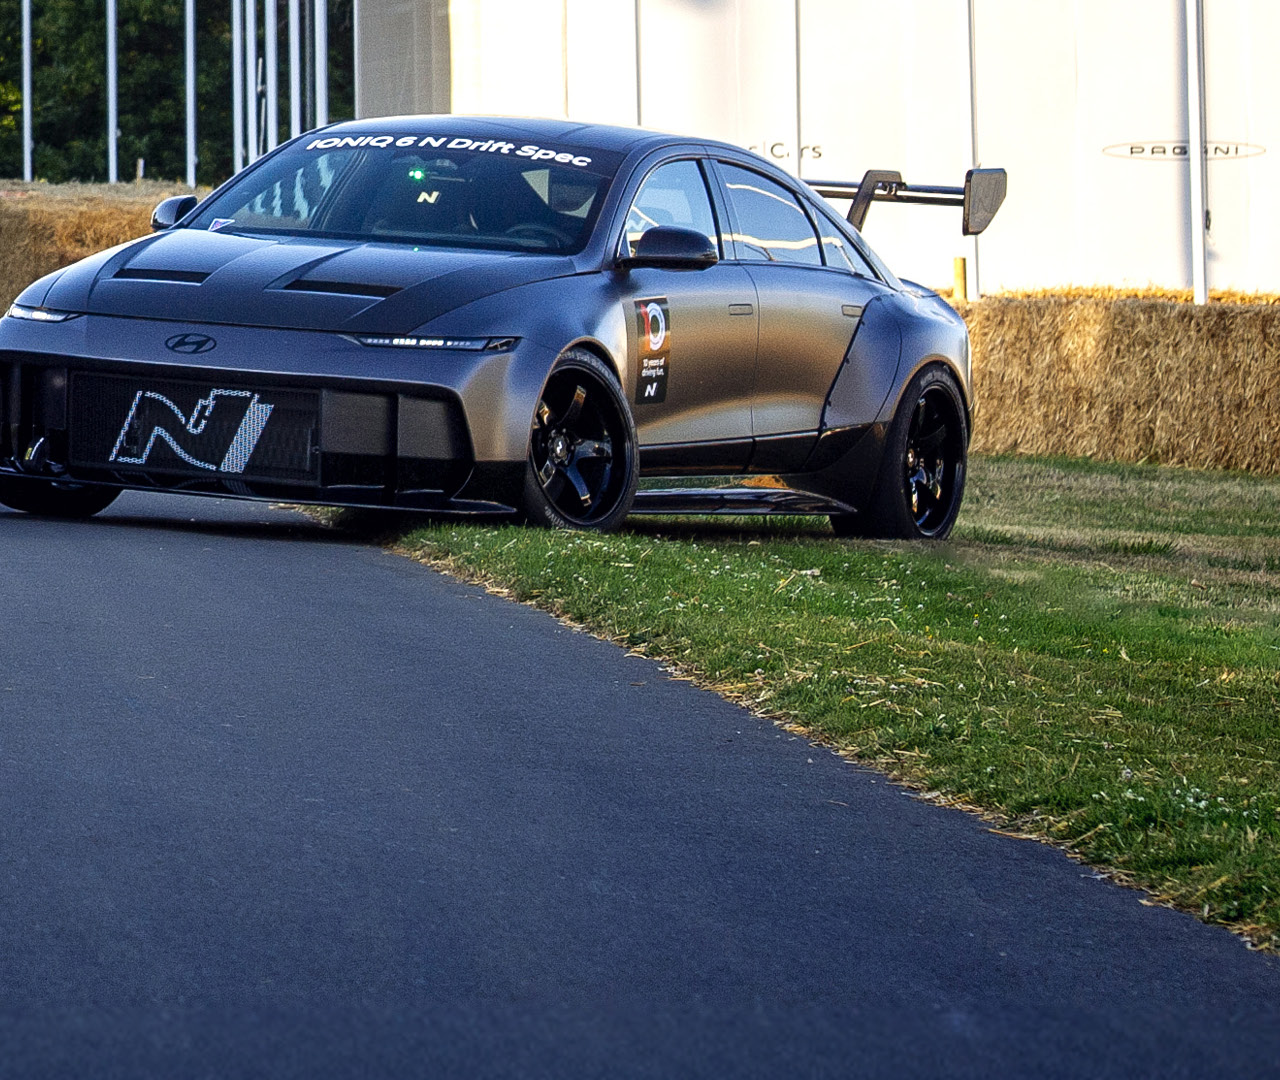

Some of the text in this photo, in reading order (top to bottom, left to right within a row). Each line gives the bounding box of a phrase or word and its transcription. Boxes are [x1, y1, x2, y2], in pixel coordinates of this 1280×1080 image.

[306, 135, 593, 167] IONIQ 6 N Drift Spec
